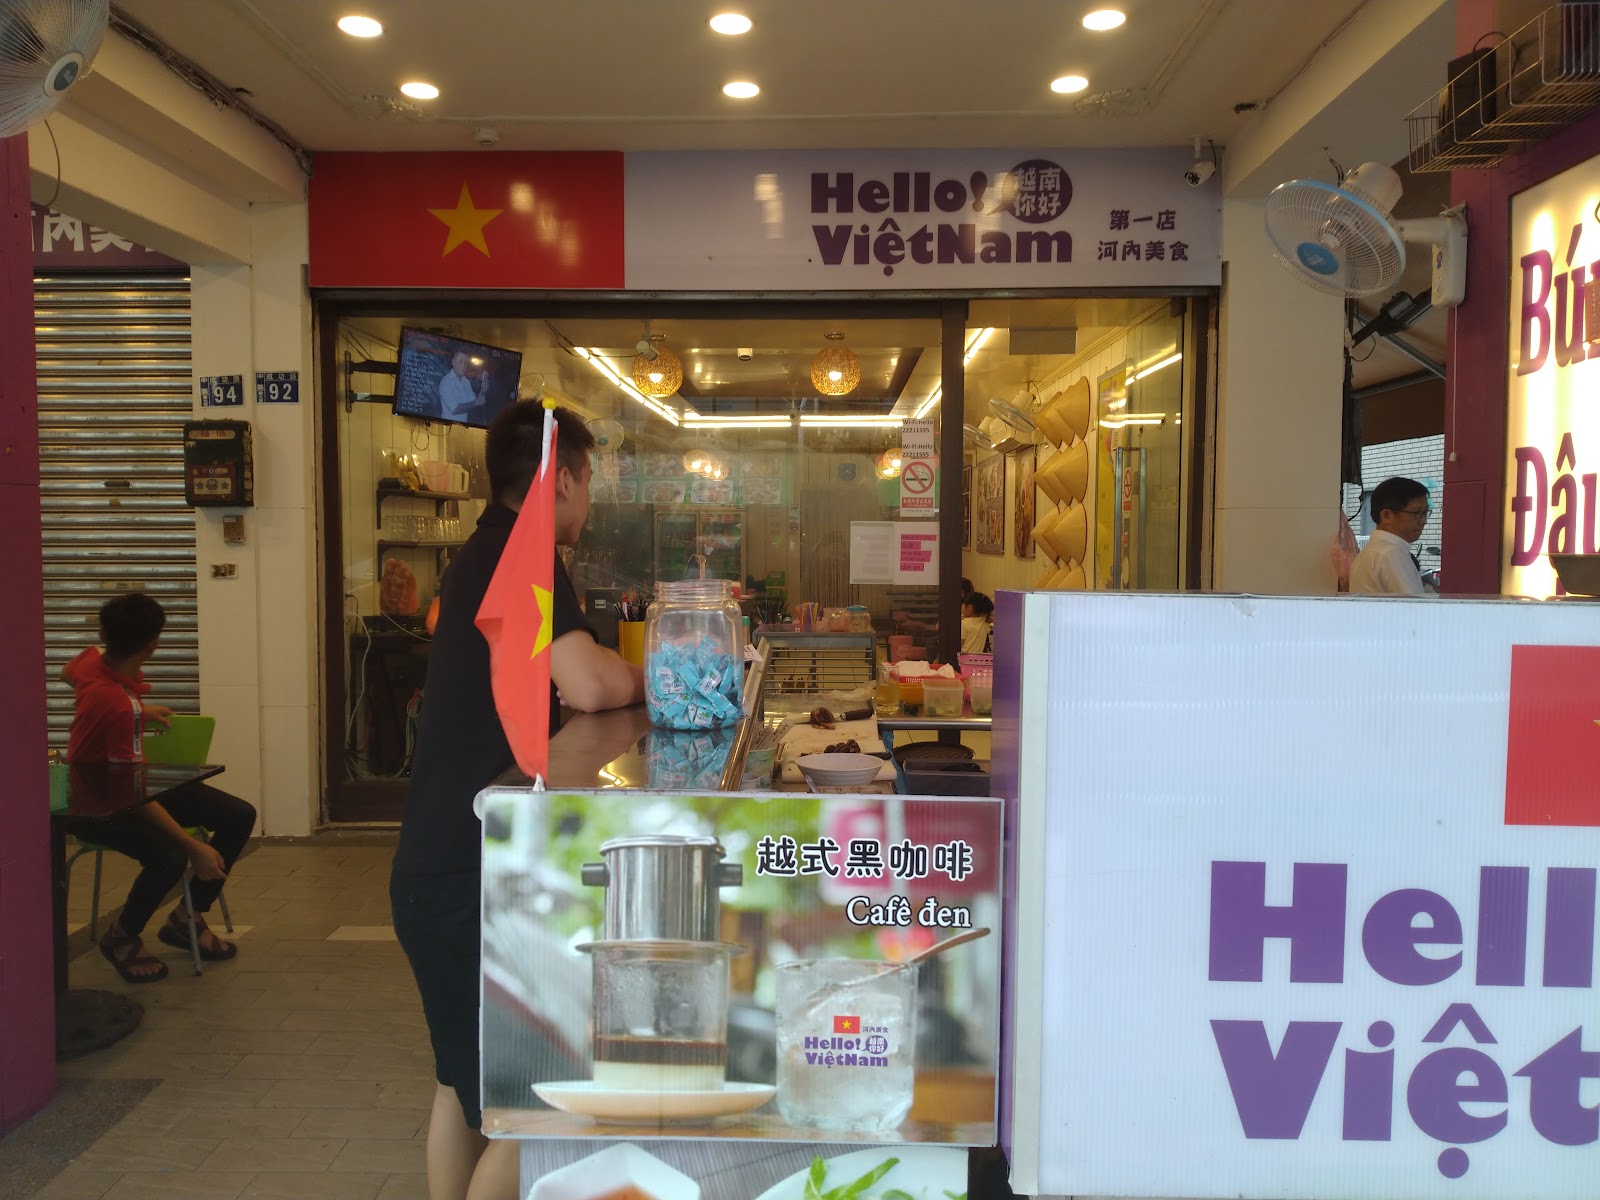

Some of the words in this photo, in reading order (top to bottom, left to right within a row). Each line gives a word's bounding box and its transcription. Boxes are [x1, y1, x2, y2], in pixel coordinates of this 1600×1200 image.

[1013, 166, 1062, 191] 越南
[810, 170, 988, 214] Hello!
[1013, 192, 1062, 217] 你好
[1109, 208, 1177, 231] 第一店
[811, 217, 1073, 277] ViệtNam
[1097, 239, 1190, 262] 河內美食
[1516, 222, 1600, 377] Bú
[213, 385, 237, 404] 94
[268, 383, 292, 400] 92
[757, 836, 973, 880] 越式黑咖啡
[846, 895, 911, 926] Cafê
[918, 896, 972, 928] đen
[1208, 860, 1597, 989] Hell
[804, 1036, 861, 1051] Hello!
[805, 1051, 888, 1068] ViệtNam
[1209, 1002, 1600, 1179] Việt
